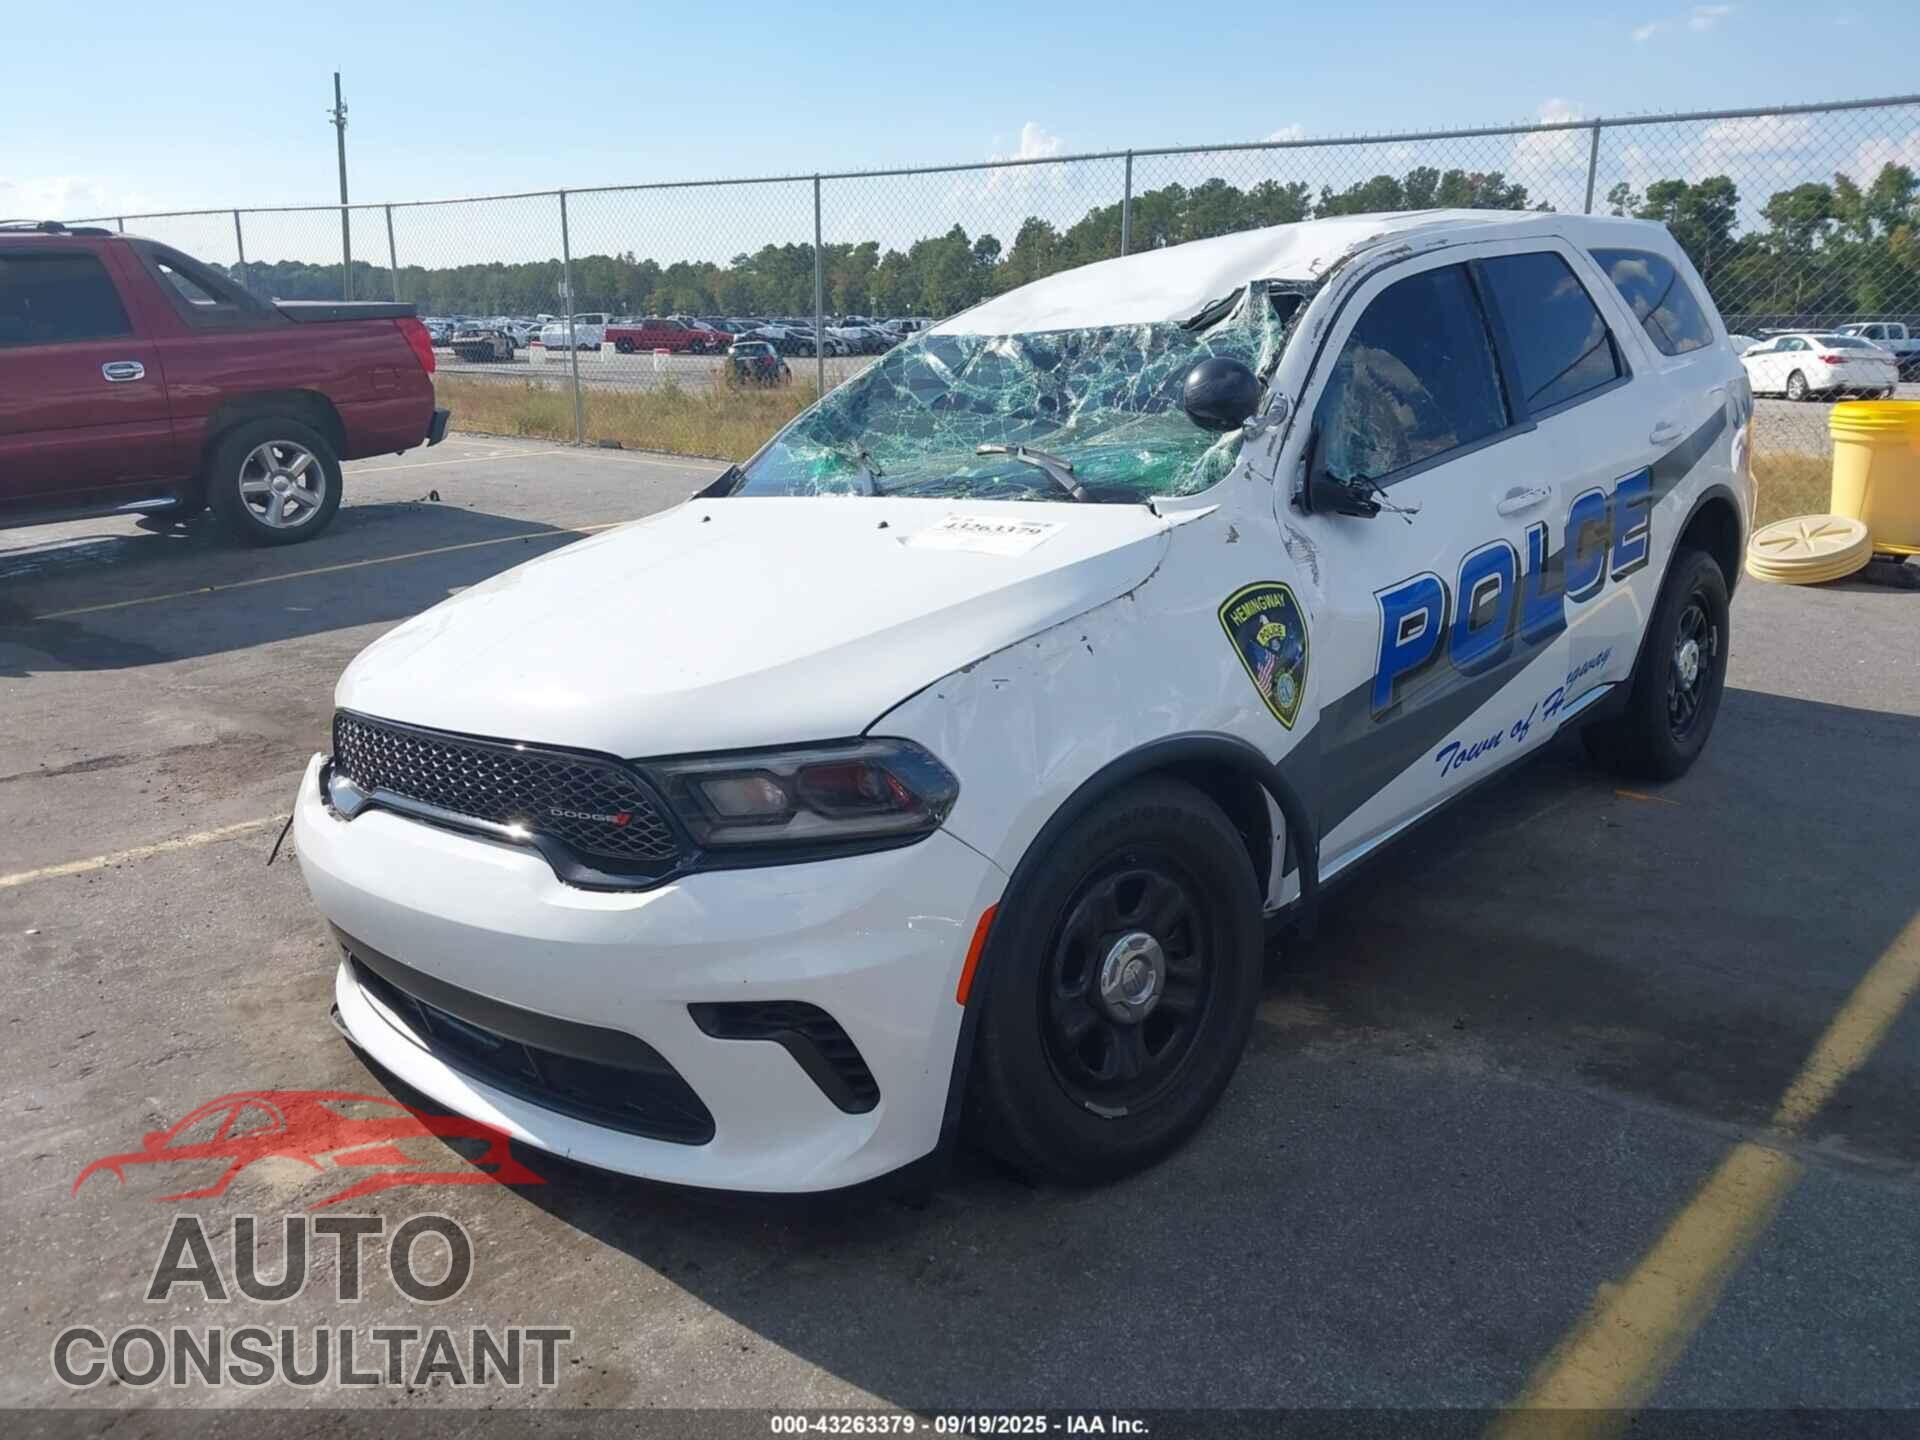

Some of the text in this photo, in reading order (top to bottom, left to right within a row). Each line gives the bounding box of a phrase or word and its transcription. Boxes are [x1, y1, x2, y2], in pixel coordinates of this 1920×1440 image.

[1229, 593, 1287, 627] HEMINGWAY
[1435, 730, 1504, 778] Town
[1509, 702, 1539, 743] of
[550, 808, 618, 823] DODGE
